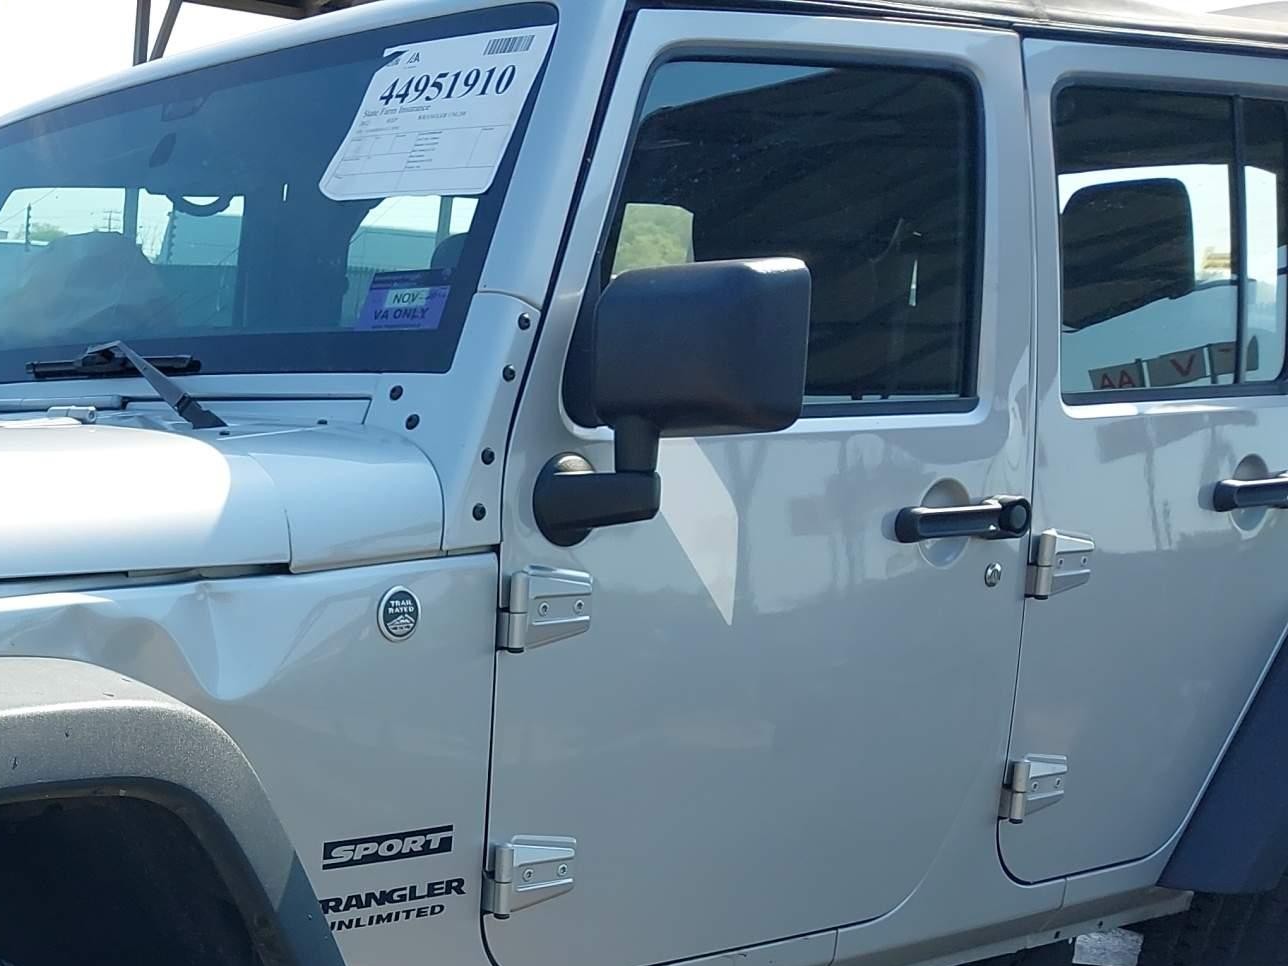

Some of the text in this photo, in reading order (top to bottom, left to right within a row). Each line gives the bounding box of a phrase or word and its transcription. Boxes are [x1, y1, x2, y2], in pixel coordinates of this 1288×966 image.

[379, 64, 516, 106] 44951910
[374, 307, 430, 320] VA ONLY
[387, 606, 415, 615] RATED
[389, 599, 413, 607] TRAIL
[322, 830, 453, 865] SPORT
[318, 876, 467, 915] RANGLER
